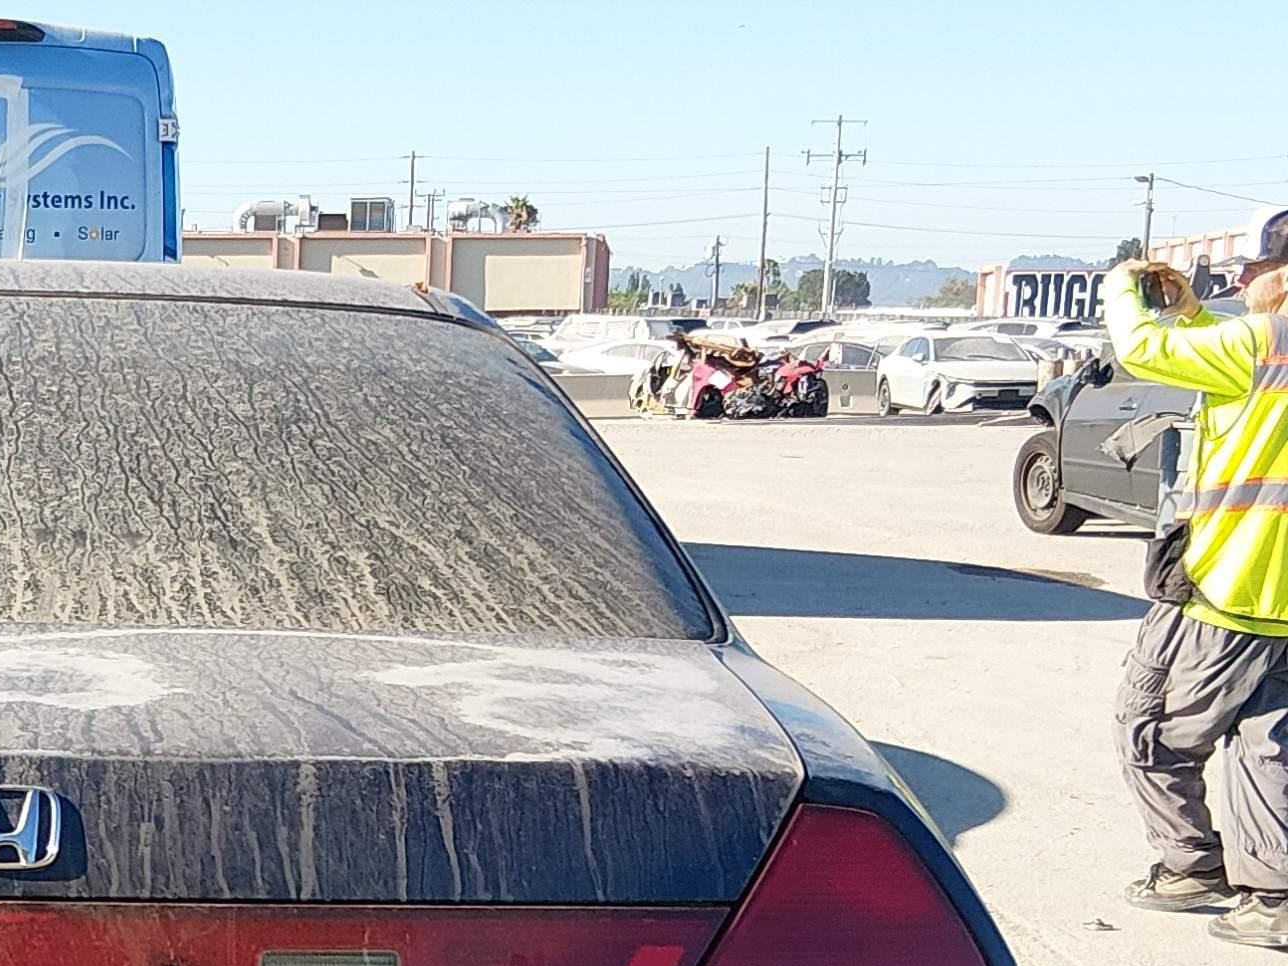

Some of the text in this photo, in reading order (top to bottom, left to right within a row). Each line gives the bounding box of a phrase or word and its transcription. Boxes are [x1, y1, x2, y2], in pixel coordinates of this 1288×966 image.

[11, 190, 93, 210] stems
[99, 190, 136, 210] Inc.
[1013, 273, 1108, 318] RUGE
